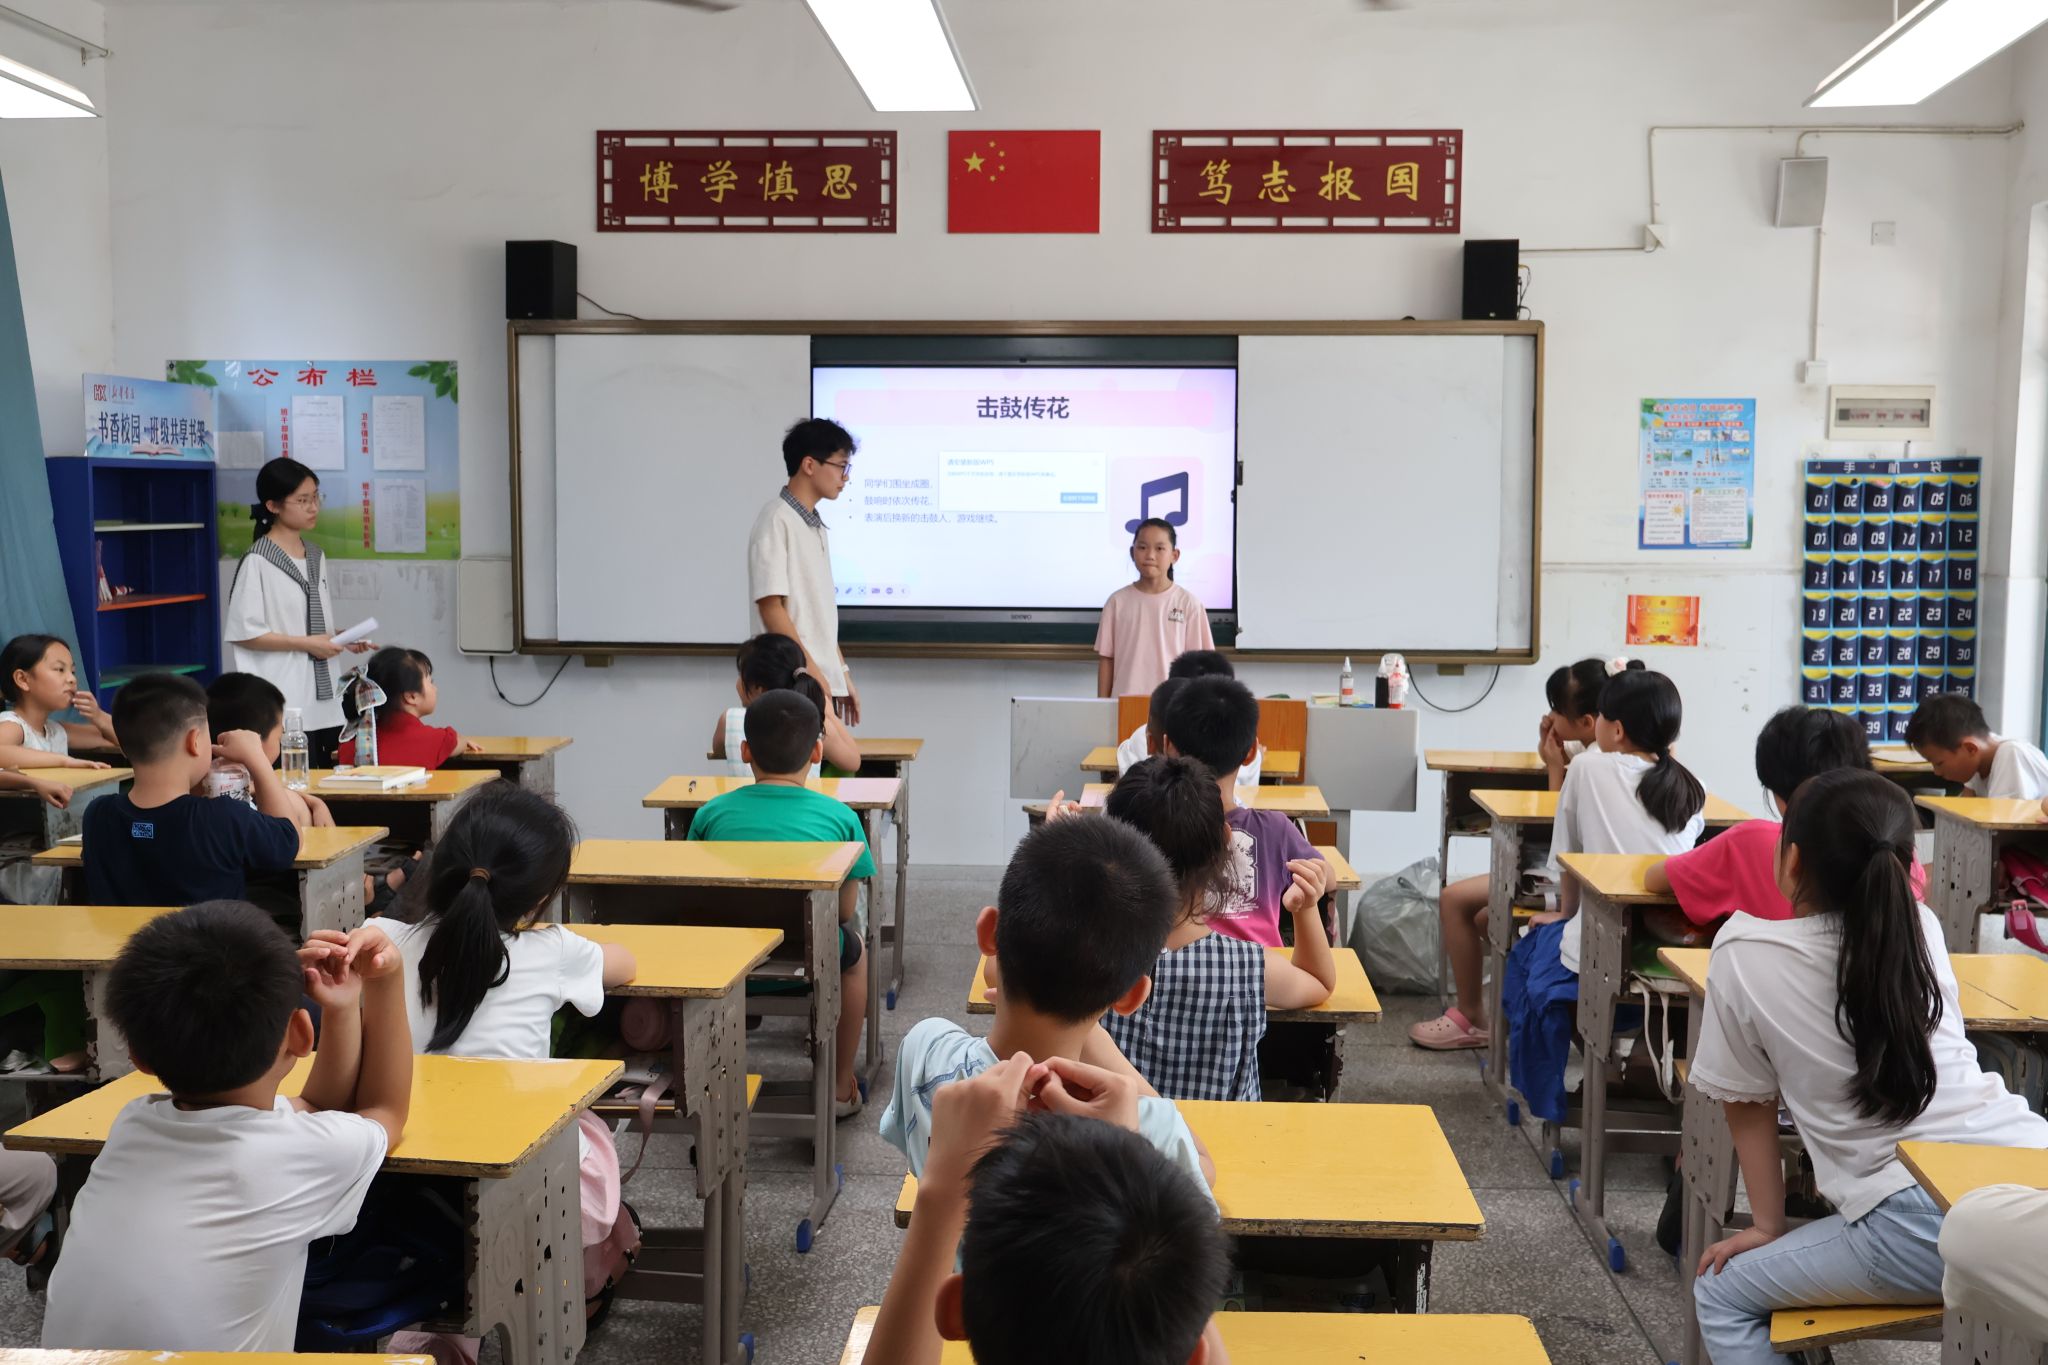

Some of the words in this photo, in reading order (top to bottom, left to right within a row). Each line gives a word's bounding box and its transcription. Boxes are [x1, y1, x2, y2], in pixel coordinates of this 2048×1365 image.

[639, 160, 858, 204] 博学慎思
[1198, 159, 1421, 206] 笃志报国
[247, 367, 378, 387] 公布栏
[976, 396, 1070, 420] 击鼓传花
[1814, 494, 1828, 507] 01
[1844, 494, 1857, 507] 02
[1873, 494, 1887, 507] 03
[1903, 494, 1915, 507] 04
[1931, 493, 1944, 505] 05
[1959, 494, 1972, 506] 06
[1814, 532, 1826, 545] 07
[1843, 532, 1857, 545] 08
[1871, 531, 1885, 545] 09
[1903, 532, 1915, 545] 10
[1931, 531, 1942, 544] 11
[1959, 530, 1972, 542] 12
[1815, 571, 1827, 584] 13
[1843, 570, 1855, 584] 14
[1872, 570, 1885, 584] 15
[1901, 570, 1913, 583] 16
[1929, 569, 1941, 582] 17
[1958, 569, 1972, 580] 18
[1812, 608, 1825, 621] 19
[1841, 608, 1855, 621] 20
[1869, 607, 1884, 620] 21
[1898, 608, 1912, 621] 22
[1927, 608, 1941, 620] 23
[1958, 608, 1971, 620] 24
[1812, 648, 1825, 661] 25
[1840, 647, 1853, 660] 26
[1869, 646, 1883, 659] 27
[1897, 647, 1911, 660] 28
[1926, 647, 1940, 658] 29
[1956, 648, 1970, 661] 30
[1811, 685, 1824, 698] 31
[1840, 685, 1853, 698] 32
[1868, 683, 1882, 696] 33
[1898, 685, 1911, 698] 34
[1866, 720, 1880, 734] 39
